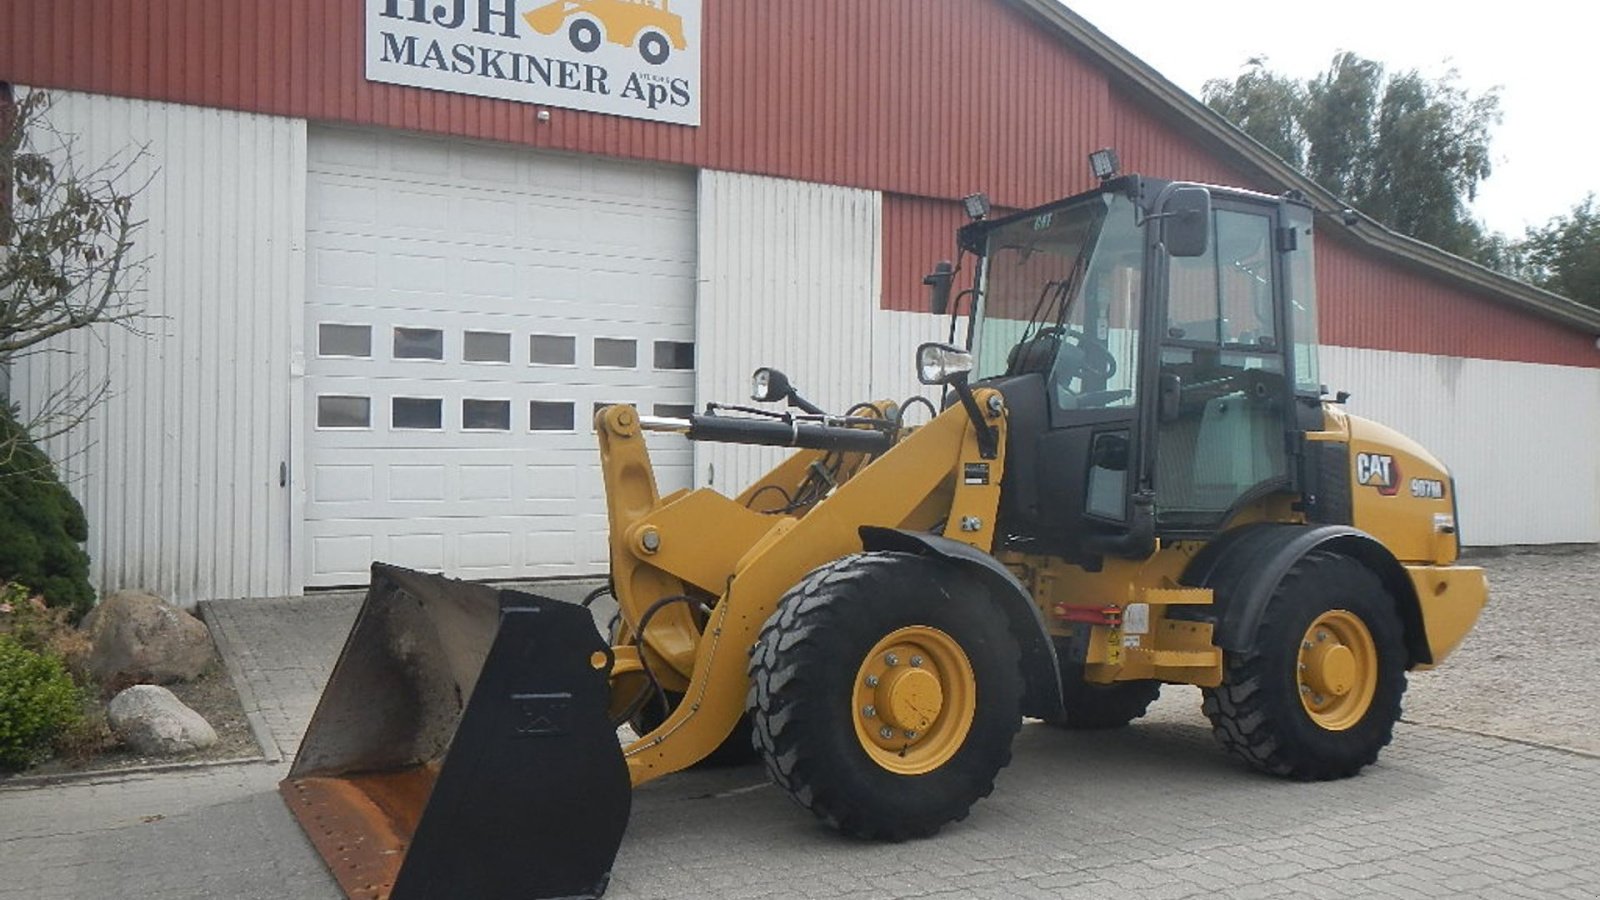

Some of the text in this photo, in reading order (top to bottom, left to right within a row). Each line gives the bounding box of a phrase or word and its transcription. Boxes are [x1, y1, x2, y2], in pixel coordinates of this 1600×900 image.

[379, 31, 690, 110] MASKINER ApS
[1357, 452, 1392, 486] CAT
